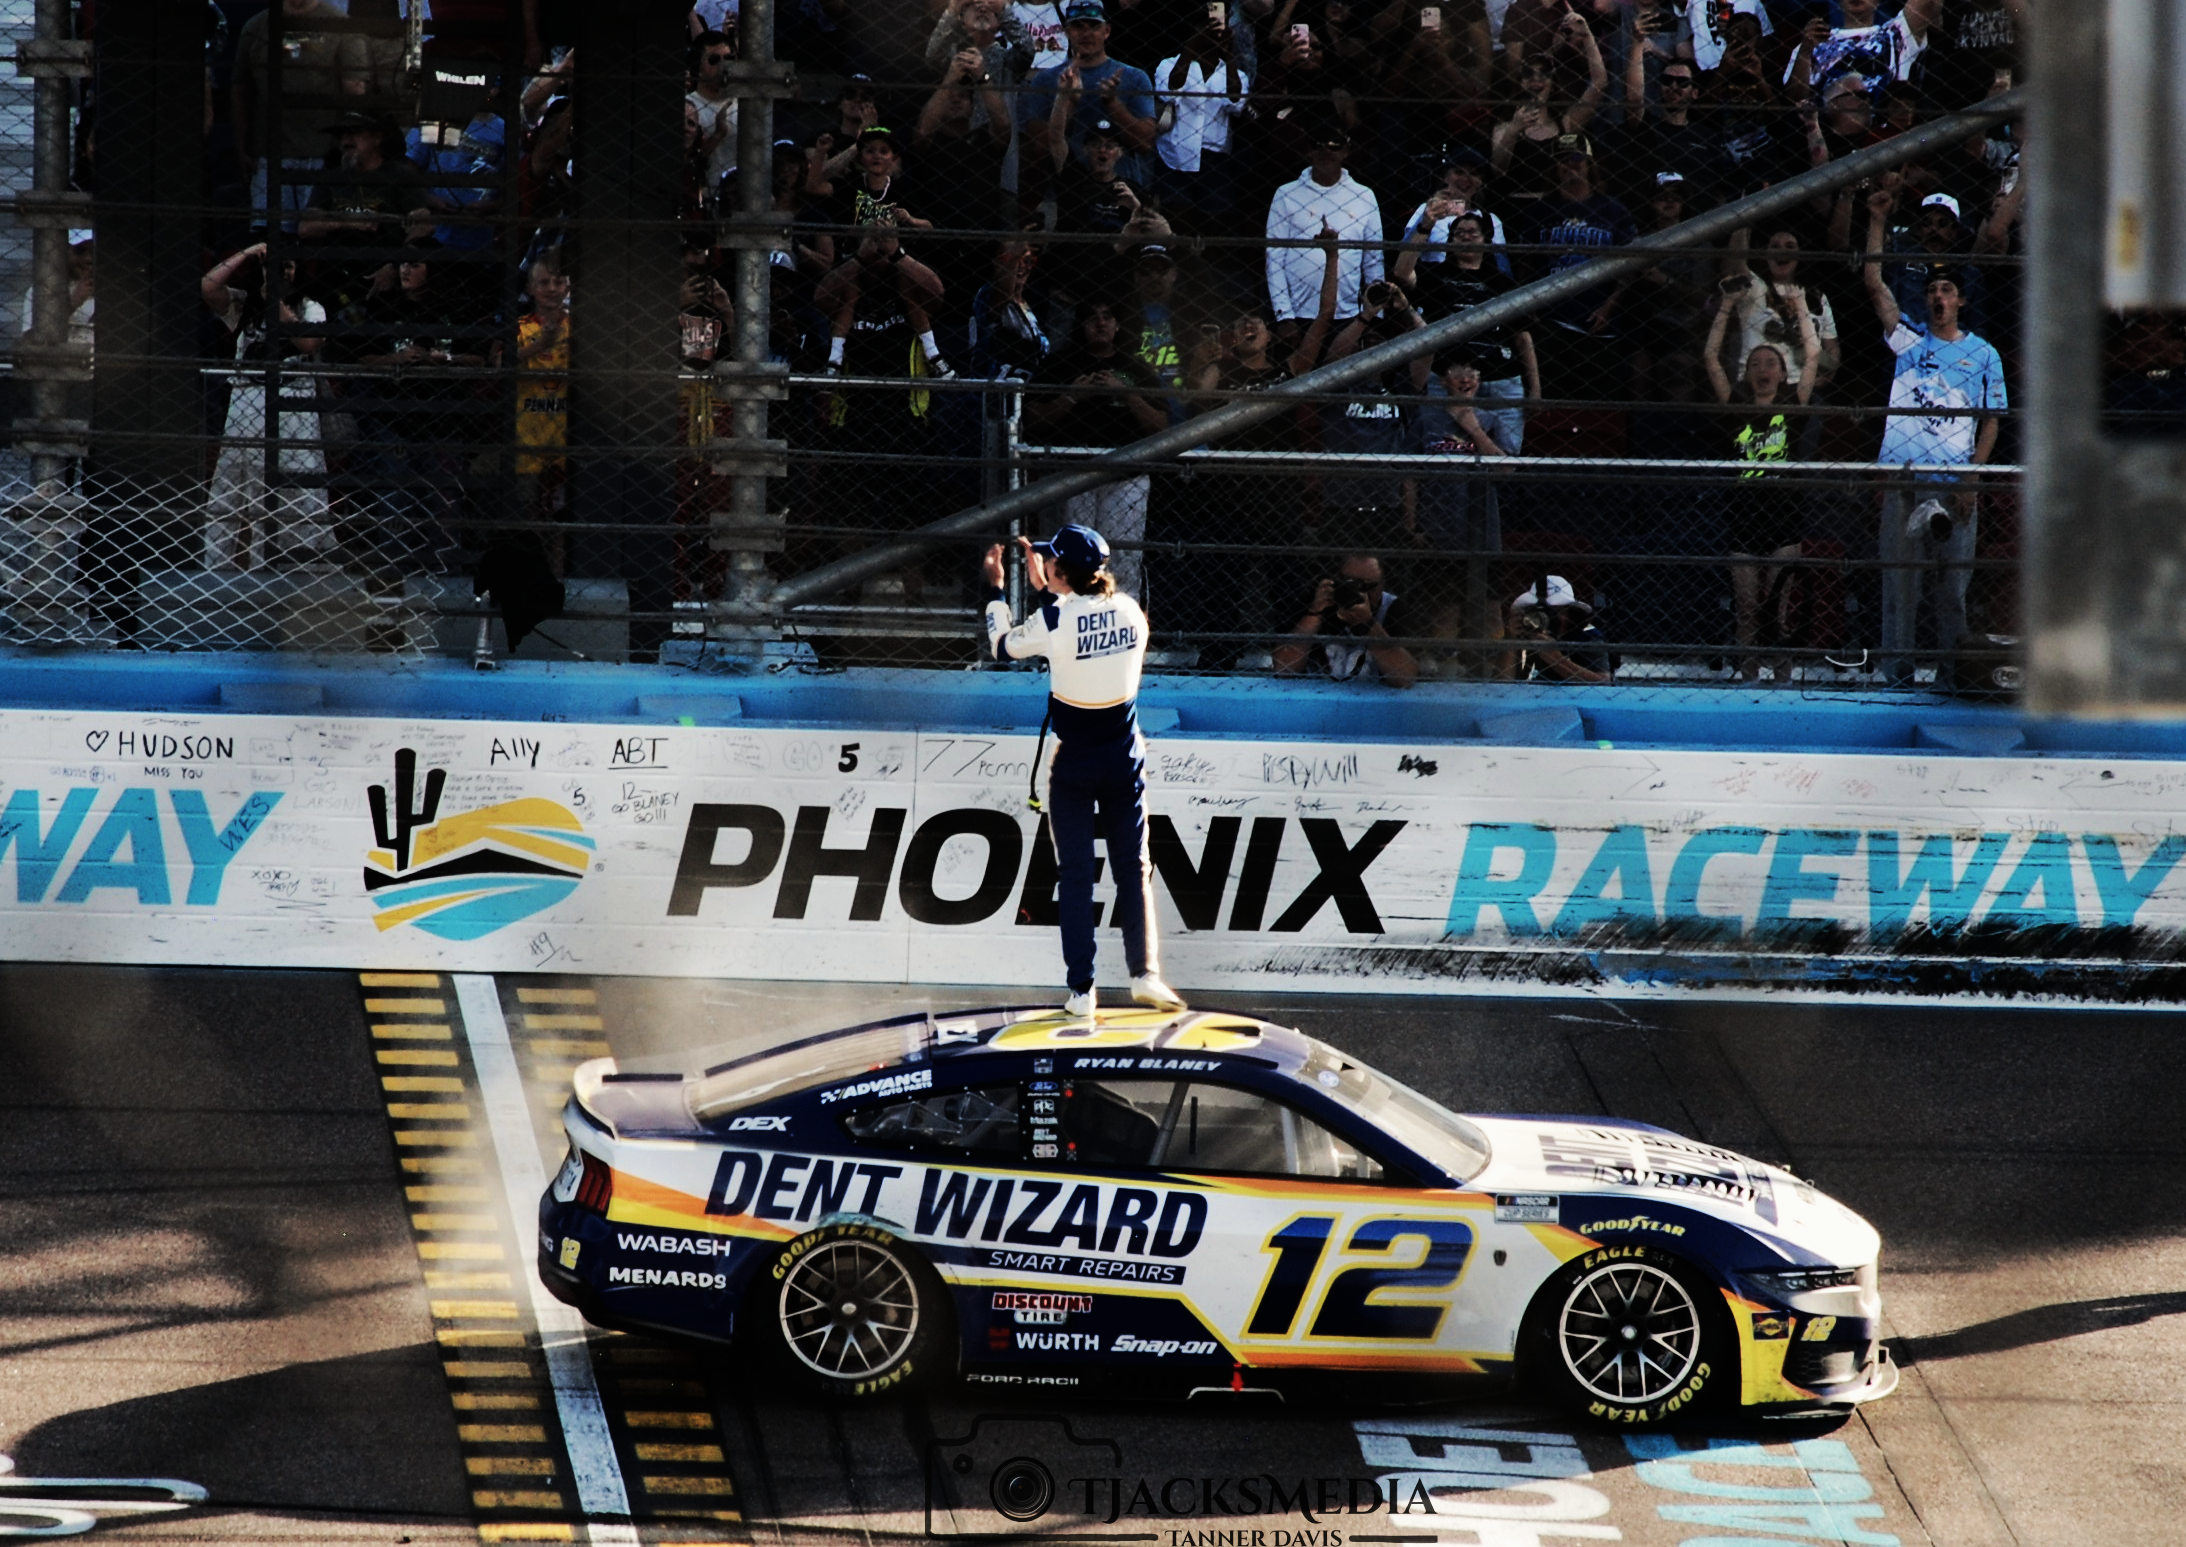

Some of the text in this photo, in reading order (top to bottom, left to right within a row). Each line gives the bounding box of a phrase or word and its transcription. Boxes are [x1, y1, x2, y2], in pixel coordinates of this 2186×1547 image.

[1077, 609, 1117, 634] DENT
[1077, 626, 1138, 654] WIZARD
[118, 731, 234, 760] HUDSON
[612, 737, 669, 765] ABT
[838, 742, 860, 773] 5
[144, 766, 204, 780] MISS YOU
[573, 786, 587, 807] 5
[611, 792, 680, 814] GO BLANEY
[1444, 822, 2186, 946] RACEWAY
[1074, 1056, 1223, 1072] RYAN BLANEY
[842, 1069, 933, 1099] ADVANCE
[878, 1081, 933, 1098] AUTO PARTS
[728, 1115, 793, 1132] DEX
[704, 1149, 1208, 1258] DENT WIZARD
[559, 1236, 582, 1271] 12
[617, 1233, 731, 1258] WABASH
[1583, 1244, 1646, 1270] EAGLE
[608, 1266, 728, 1290] MENARDS
[988, 1251, 1177, 1282] SMART REPAIRS
[1238, 1209, 1479, 1344] 12
[991, 1292, 1093, 1313] DISCOUNT
[1020, 1311, 1063, 1323] TIRE
[1801, 1315, 1837, 1342] 12
[1015, 1332, 1100, 1351] WÜRTH
[1110, 1333, 1218, 1358] Snap-on
